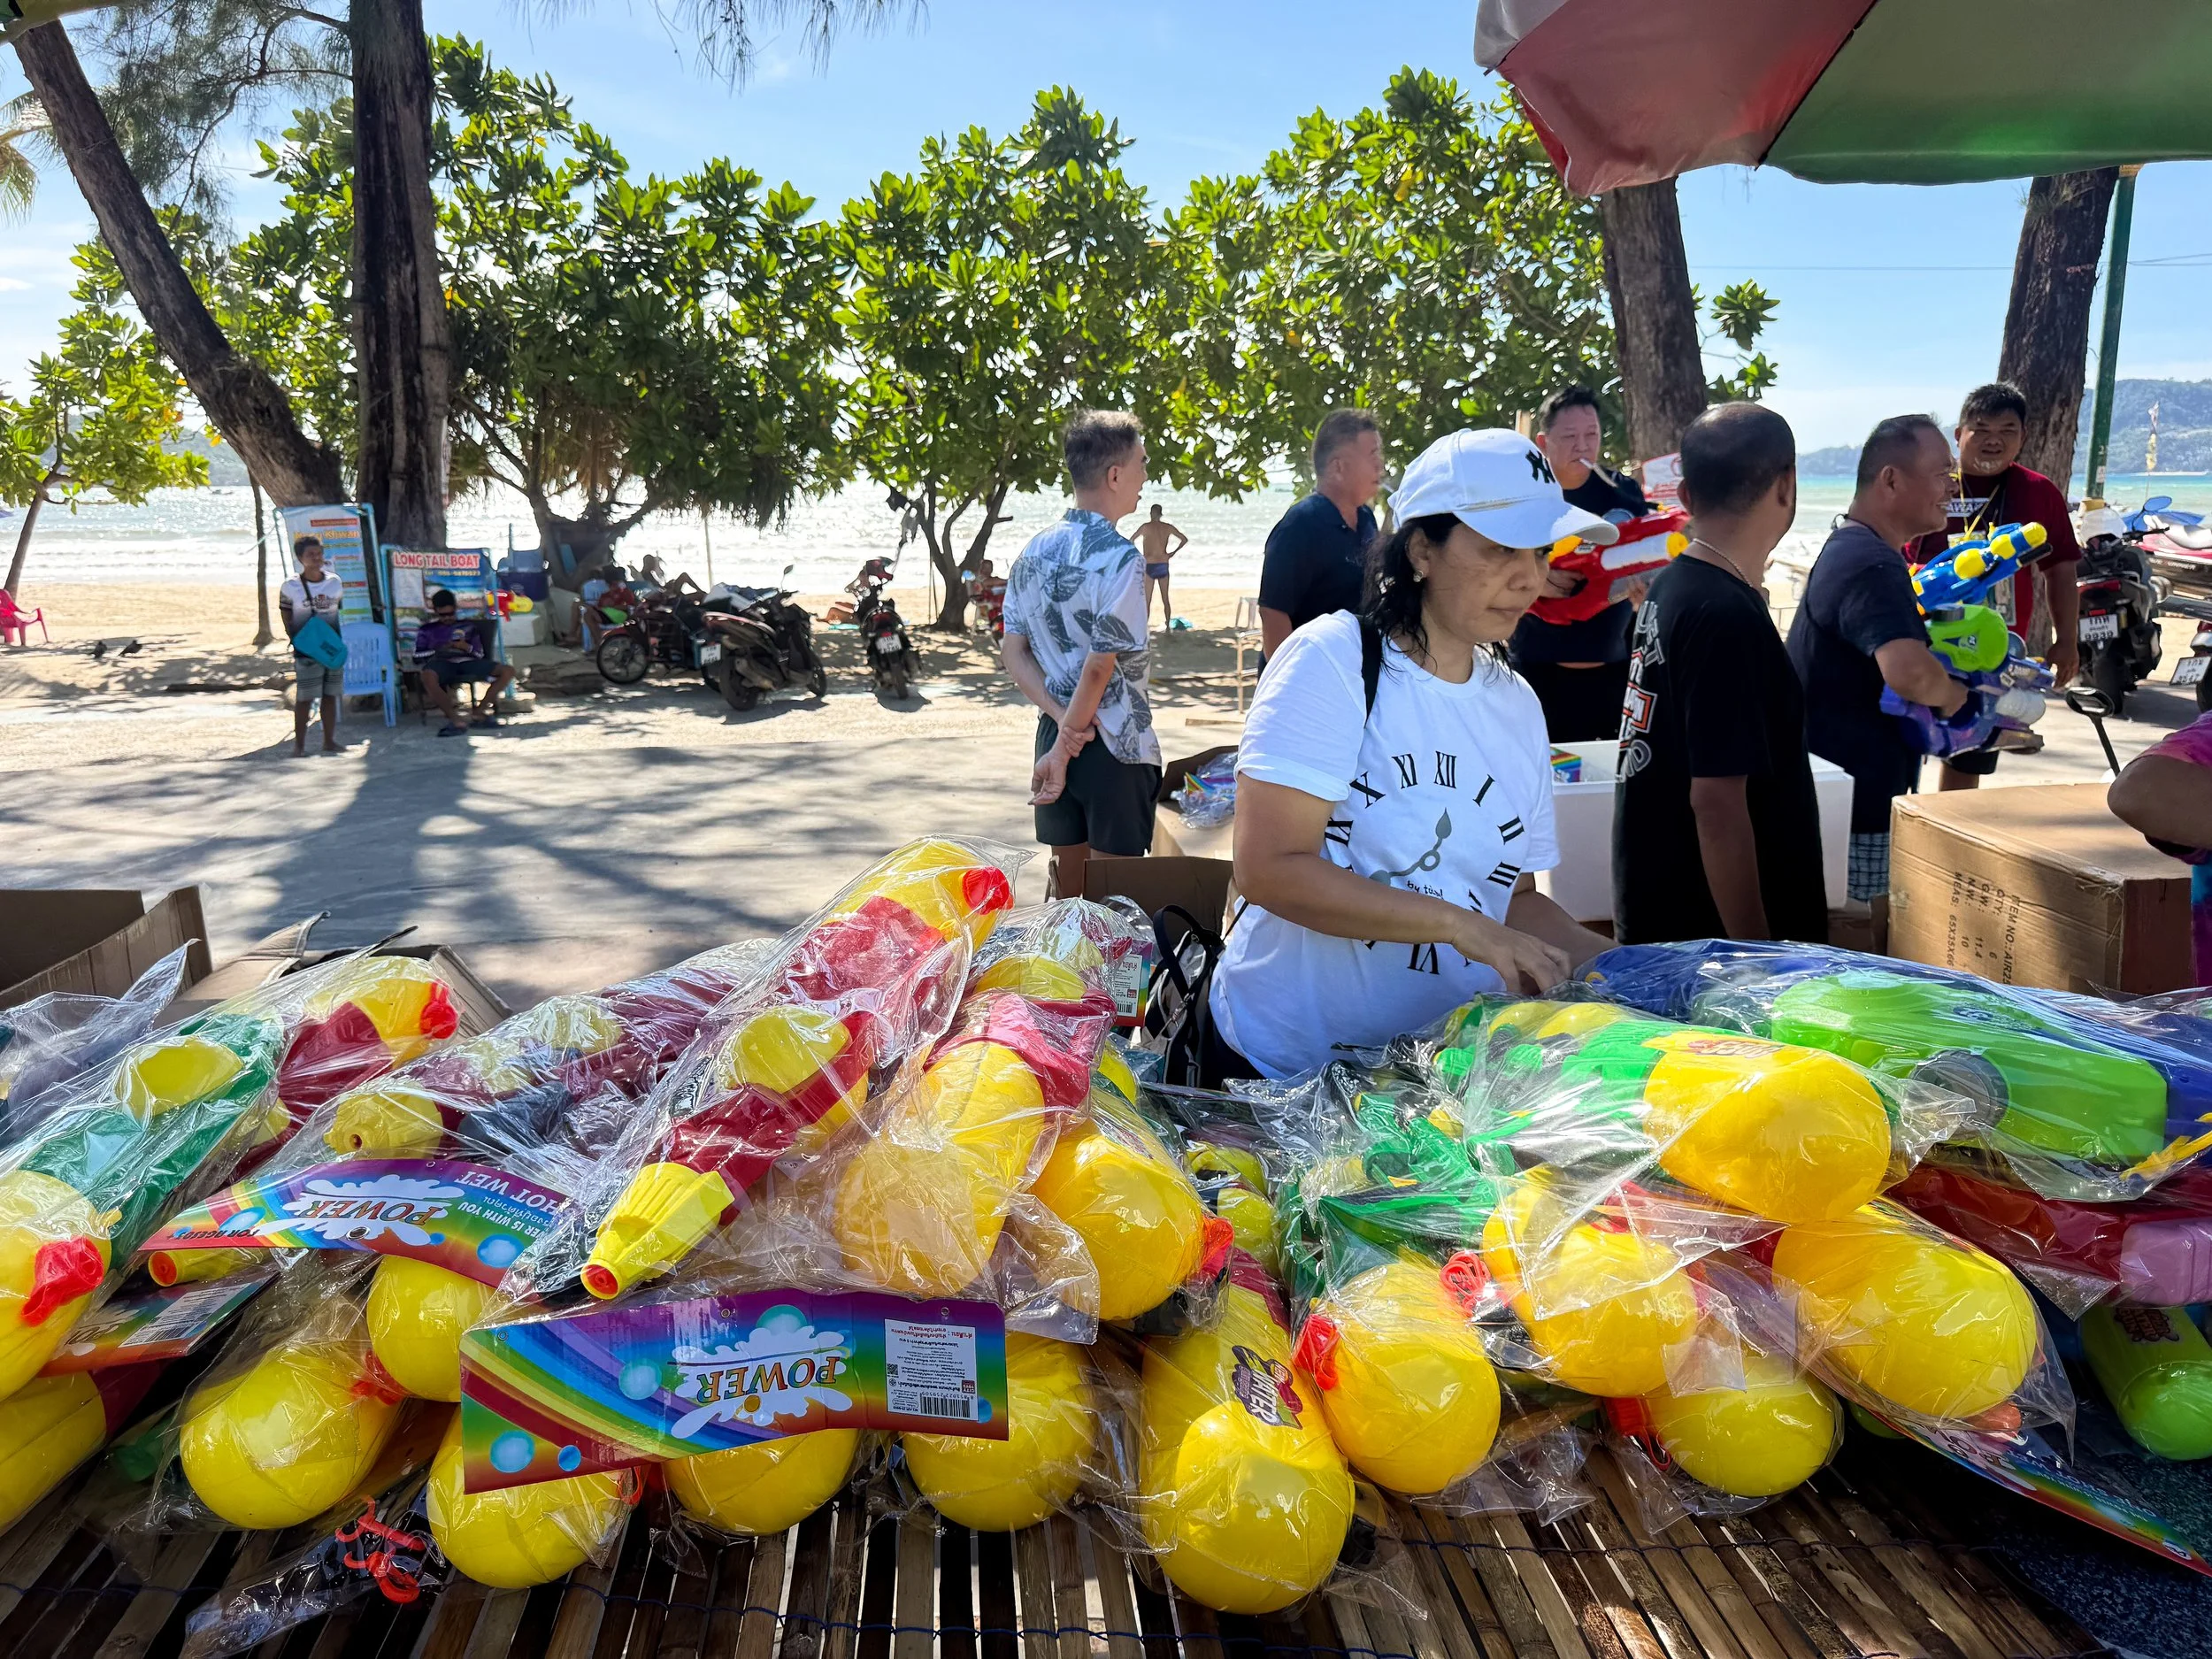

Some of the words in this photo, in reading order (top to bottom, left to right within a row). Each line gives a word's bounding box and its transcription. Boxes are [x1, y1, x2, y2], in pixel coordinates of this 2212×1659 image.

[394, 554, 424, 566] LONG
[426, 555, 449, 567] TAIL
[450, 555, 480, 568] BOAT
[1391, 753, 1418, 789] XI
[1433, 750, 1457, 788] XII
[1348, 771, 1386, 809] X
[1497, 816, 1525, 845] II
[1486, 861, 1521, 888] III
[1961, 936, 1969, 948] 10
[1975, 938, 1984, 958] 11.4
[455, 1171, 510, 1195] WET
[299, 1200, 443, 1225] POWER
[457, 1202, 482, 1217] YOU
[483, 1196, 549, 1227] รงอยู่ที่ตัวคุณ
[510, 1188, 559, 1215] HOT
[481, 1209, 511, 1226] WITH
[511, 1221, 525, 1231] IS
[696, 1356, 840, 1403] POWER
[1249, 1368, 1279, 1425] WATER
